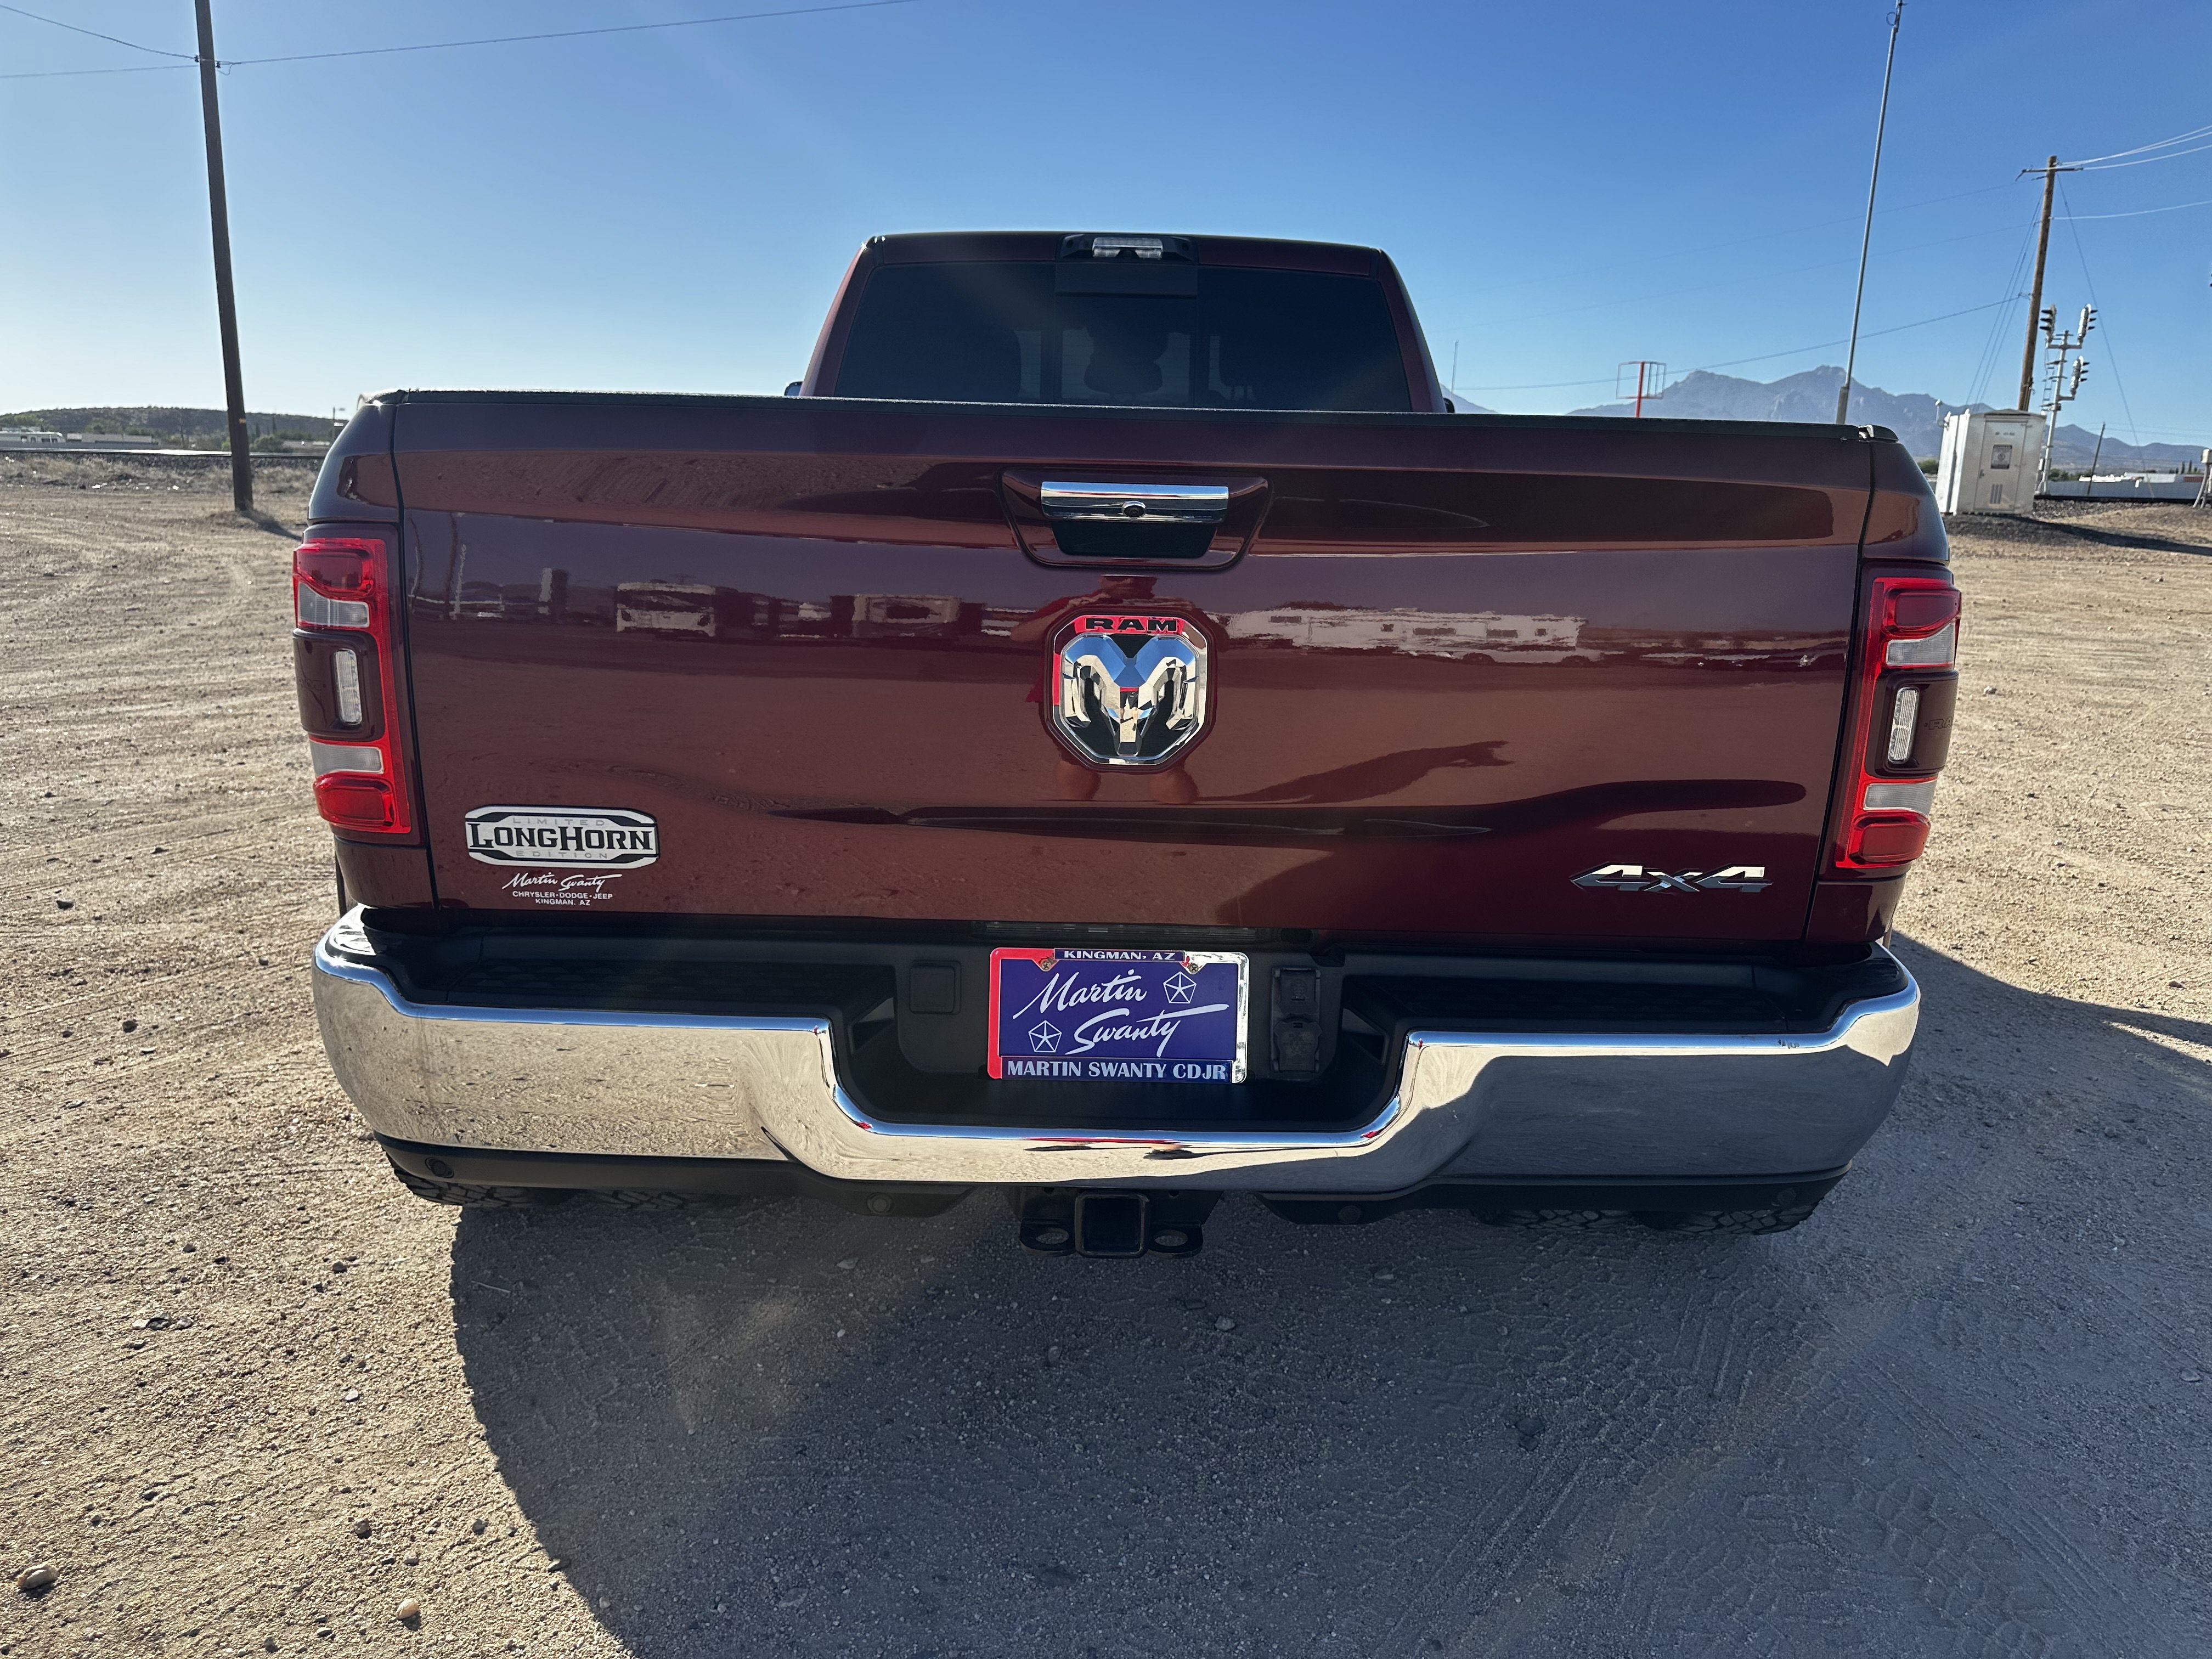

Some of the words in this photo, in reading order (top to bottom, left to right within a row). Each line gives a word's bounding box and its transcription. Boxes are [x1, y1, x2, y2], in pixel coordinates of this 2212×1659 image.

[1086, 618, 1177, 631] RAM
[1928, 716, 1953, 730] RA
[512, 817, 605, 826] LIMITED
[468, 823, 654, 851] LONGHORN
[516, 850, 608, 859] EDITION
[501, 872, 558, 890] Martin
[558, 873, 623, 893] Swanty
[1064, 950, 1147, 960] KINGMAN,
[1153, 952, 1176, 961] AZ
[1012, 969, 1147, 1019] Martin
[1064, 1004, 1229, 1058] Swanty
[1007, 1060, 1081, 1077] MARTIN
[1088, 1062, 1167, 1079] SWANTY
[1173, 1064, 1226, 1080] CDJR
